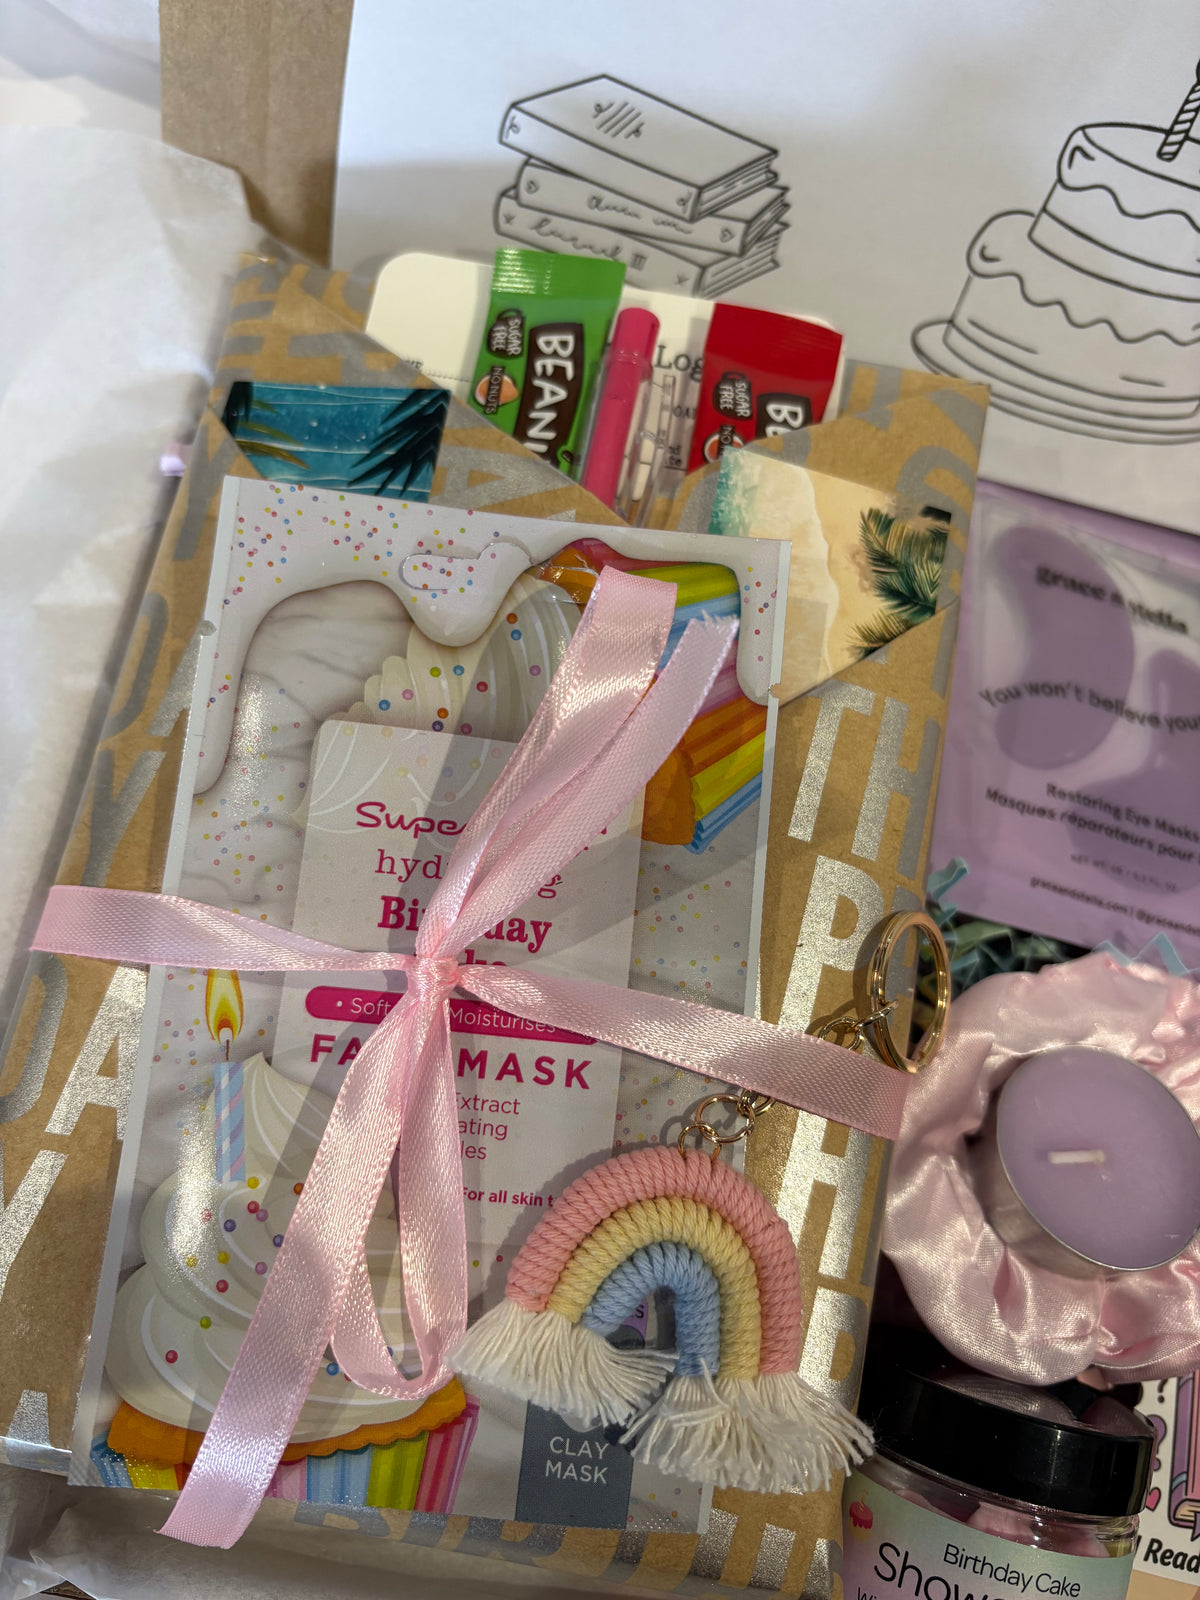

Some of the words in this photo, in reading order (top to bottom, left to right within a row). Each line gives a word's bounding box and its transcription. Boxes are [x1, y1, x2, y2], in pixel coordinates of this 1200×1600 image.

[492, 326, 507, 353] FREE
[507, 319, 522, 356] SUGAR
[490, 367, 503, 387] NO
[485, 387, 501, 414] NUTS
[522, 334, 576, 456] BEANI
[719, 386, 735, 411] FREE
[734, 380, 751, 418] SUGAR
[719, 426, 733, 444] NO
[979, 685, 1022, 708] You
[1025, 682, 1083, 702] won't
[1089, 688, 1161, 727] believe
[356, 801, 467, 839] Supe
[986, 787, 1056, 820] Masques
[1060, 811, 1154, 850] réparateurs
[1157, 843, 1195, 862] pour
[1046, 783, 1121, 820] Restoring
[1125, 807, 1151, 827] Eye
[1154, 818, 1200, 843] Masks
[449, 1006, 556, 1034] Moisturises
[457, 1048, 592, 1090] MASK
[456, 1092, 521, 1115] xtract
[488, 1190, 508, 1204] all
[512, 1191, 543, 1207] skin
[549, 1435, 610, 1460] CLAY
[545, 1459, 609, 1485] MASK
[943, 1543, 1034, 1593] Birthday
[1035, 1572, 1081, 1598] Cake
